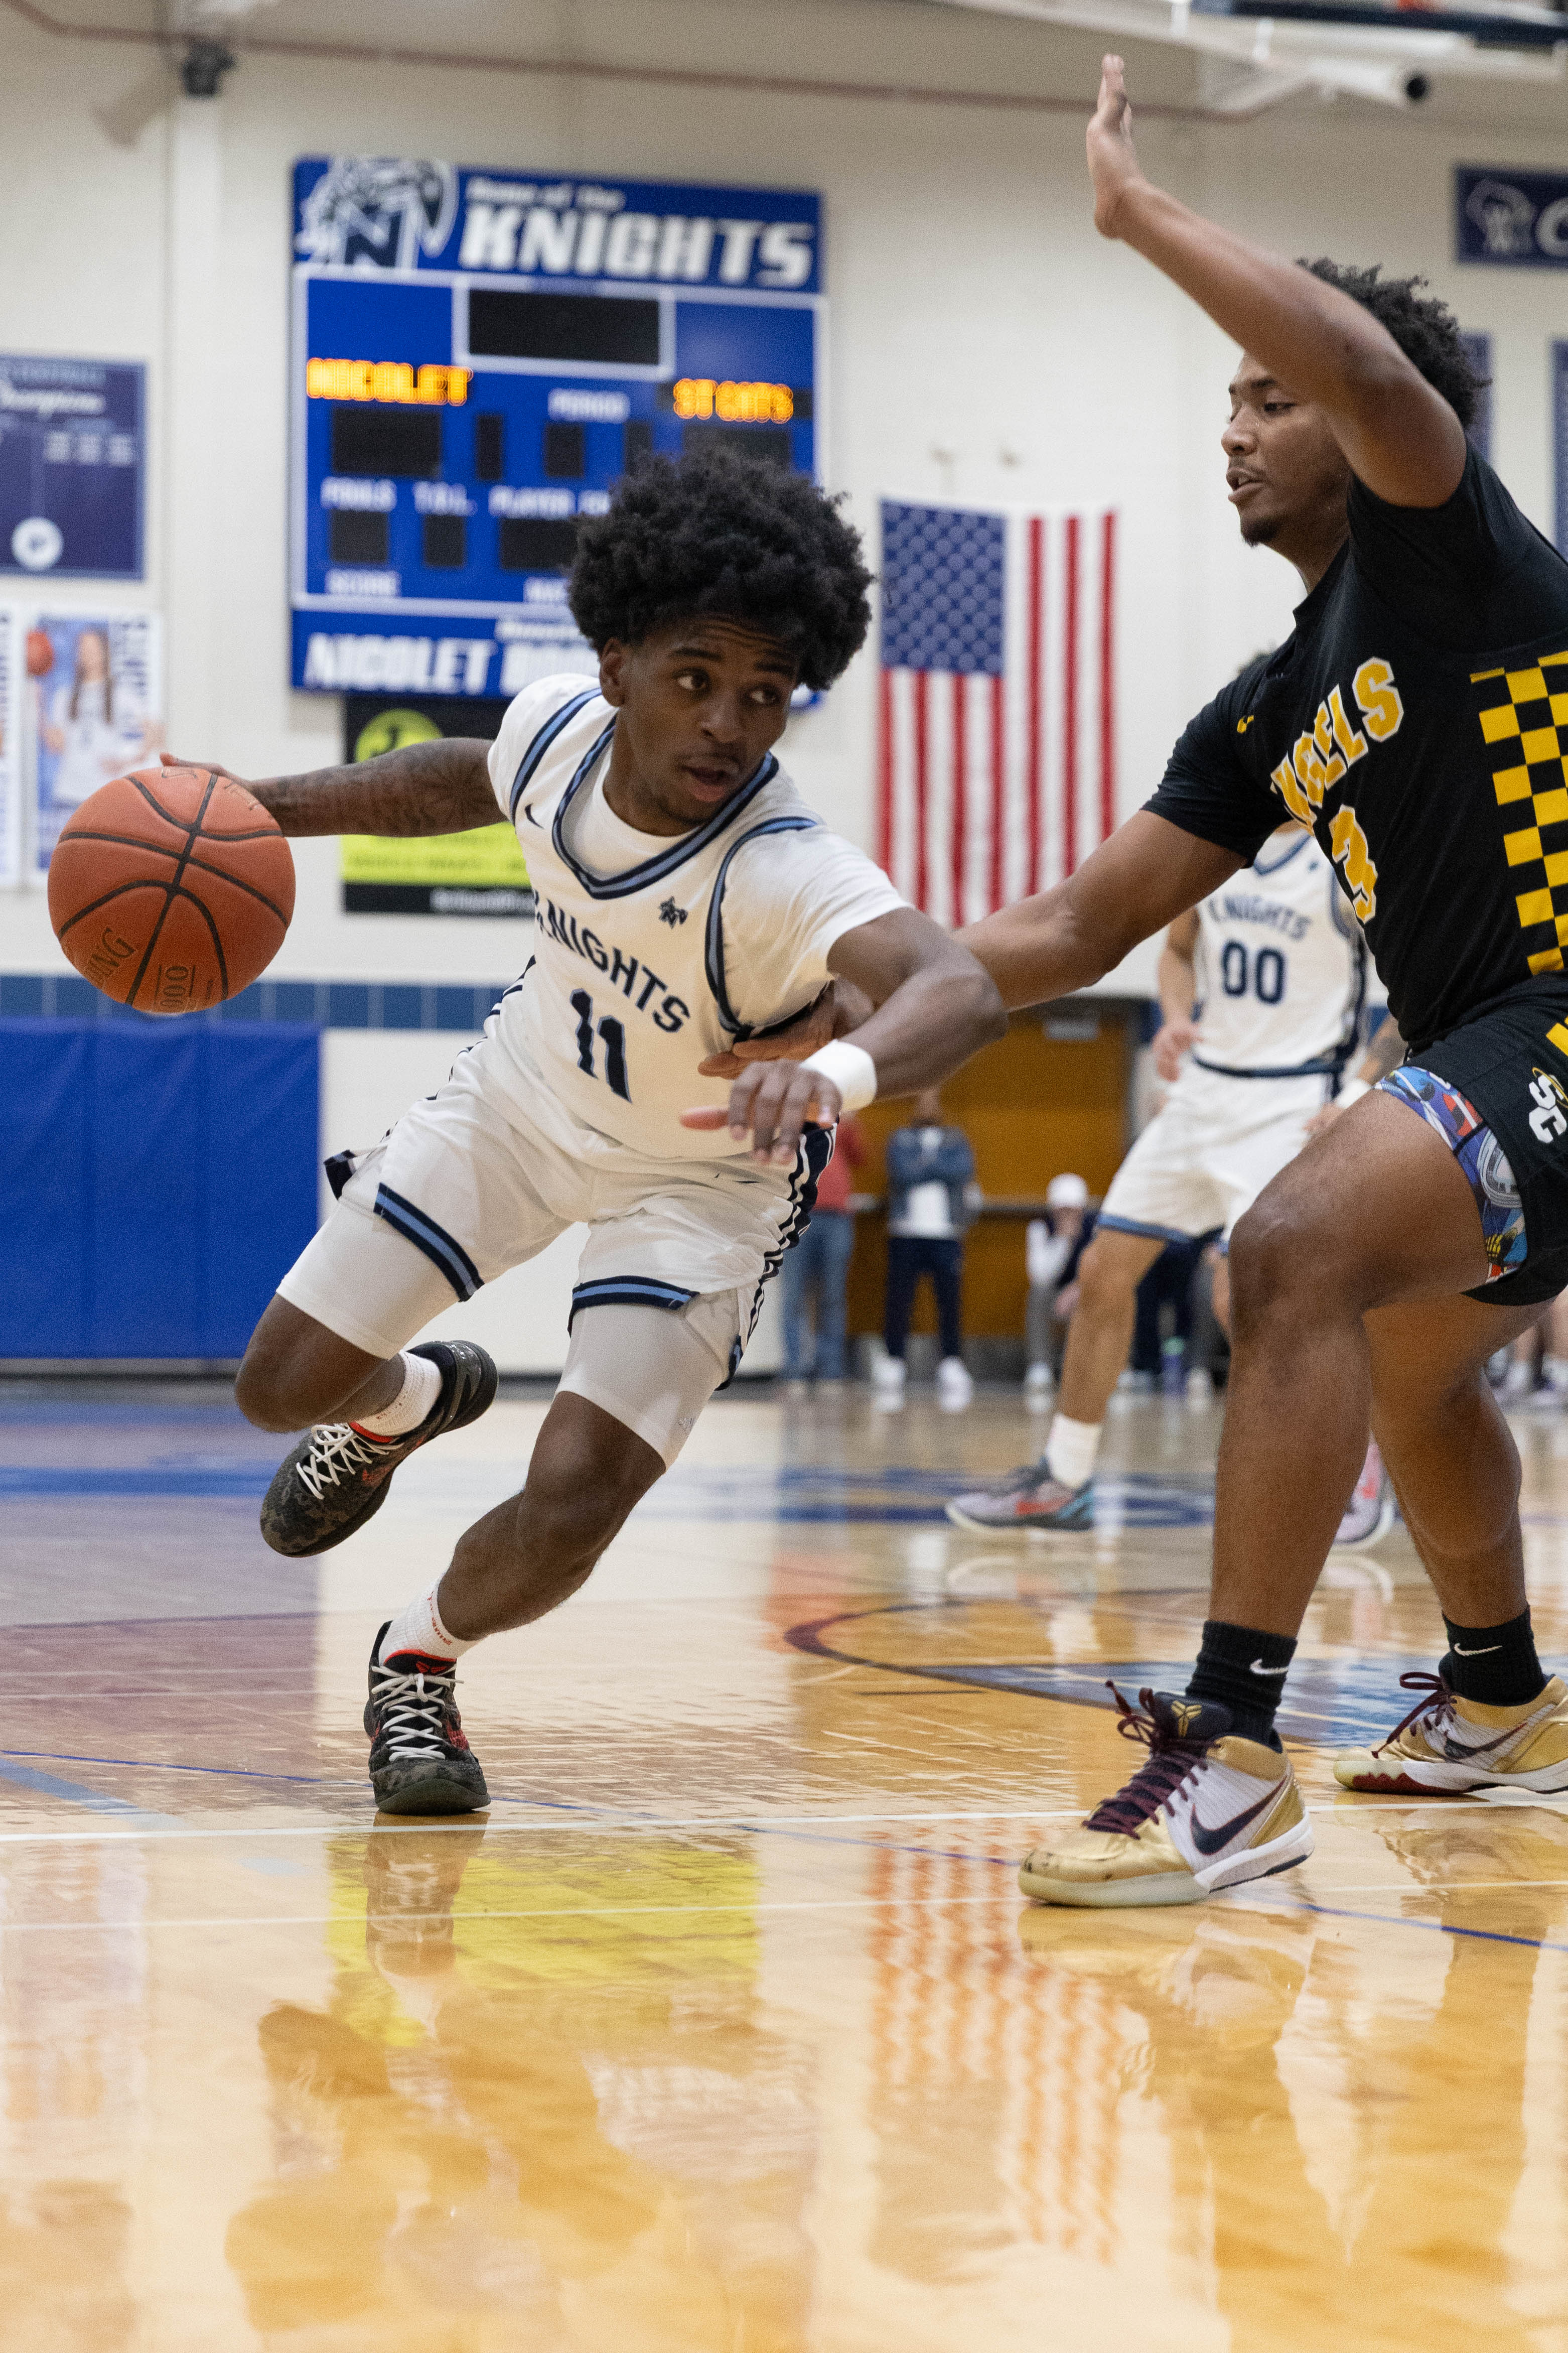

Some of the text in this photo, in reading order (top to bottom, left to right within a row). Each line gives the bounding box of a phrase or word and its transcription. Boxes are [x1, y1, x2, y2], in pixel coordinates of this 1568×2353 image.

[458, 206, 814, 289] KNIGHTS
[302, 632, 497, 696] NICOLET
[1221, 938, 1286, 1005] 00
[570, 987, 633, 1104] 11
